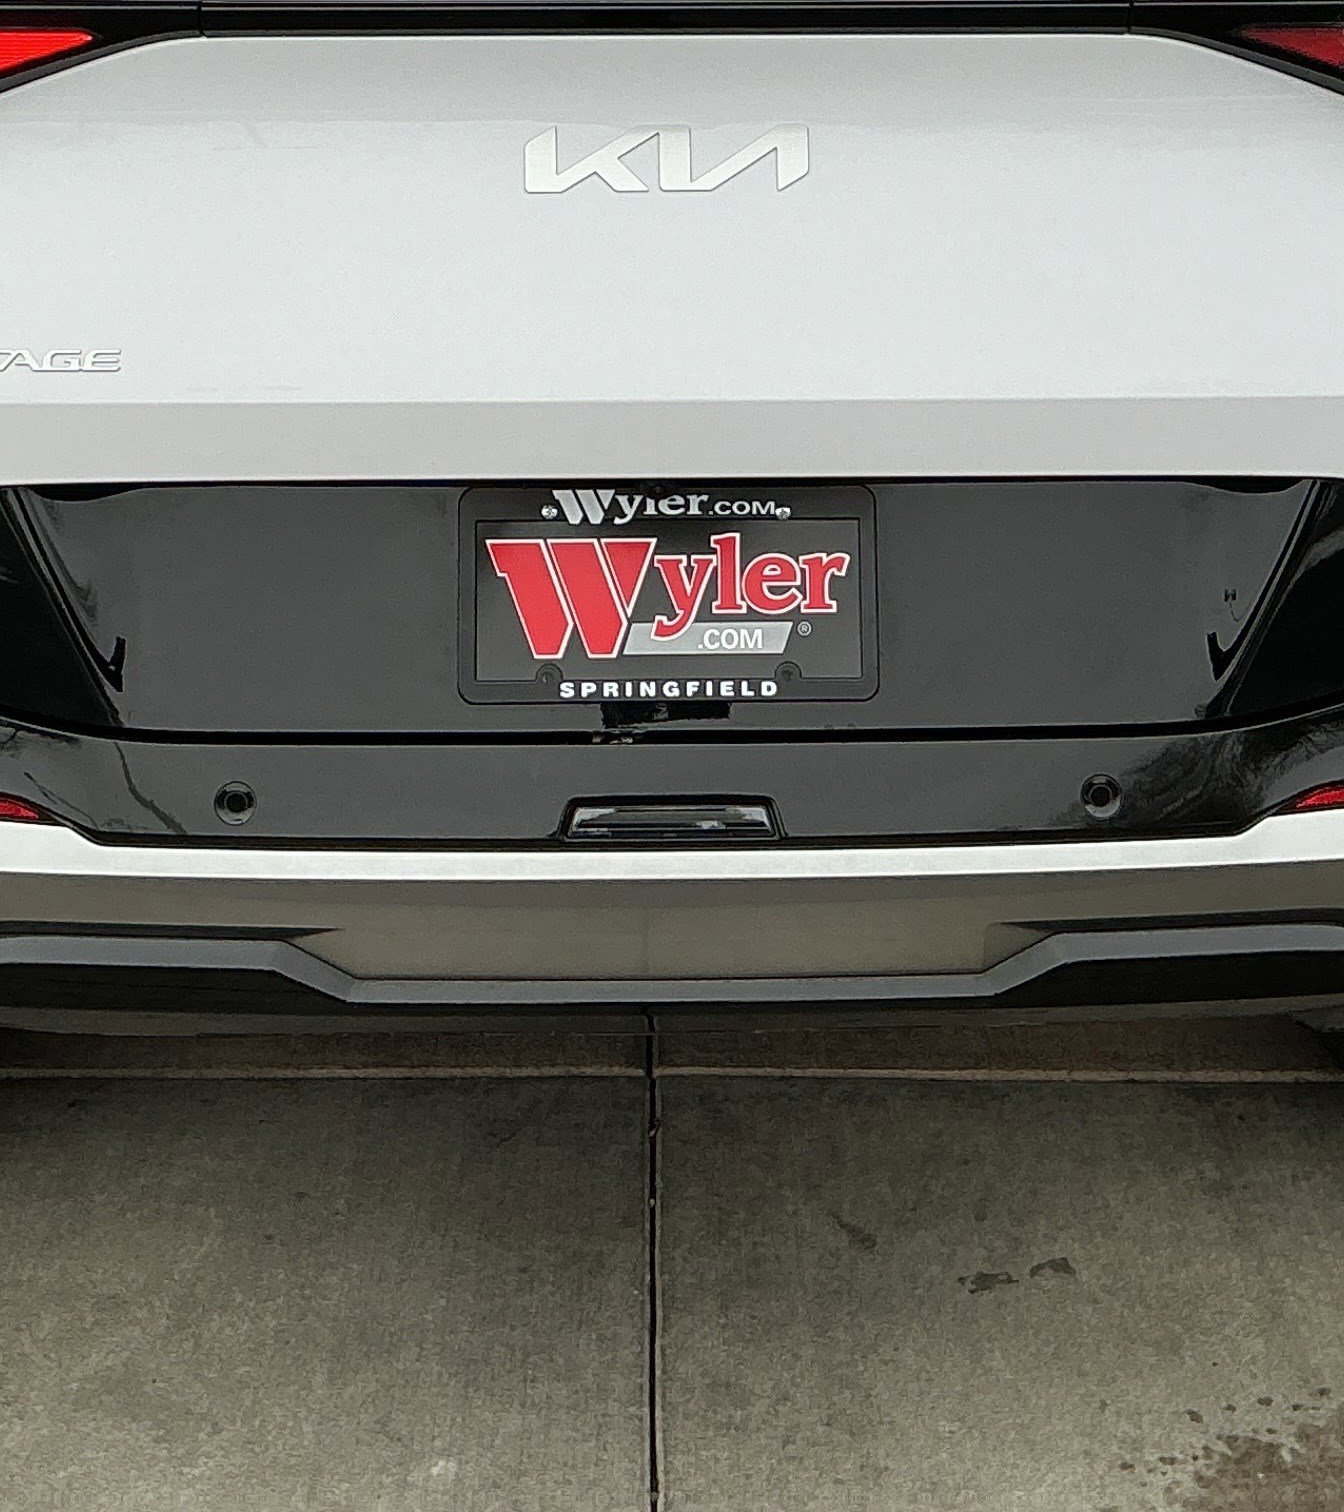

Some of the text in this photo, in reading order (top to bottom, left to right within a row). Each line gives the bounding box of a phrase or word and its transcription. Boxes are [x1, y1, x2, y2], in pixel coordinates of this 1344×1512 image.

[485, 532, 850, 659] Wyler
[697, 627, 764, 650] .COM
[559, 680, 778, 699] SPRINGFIELD
